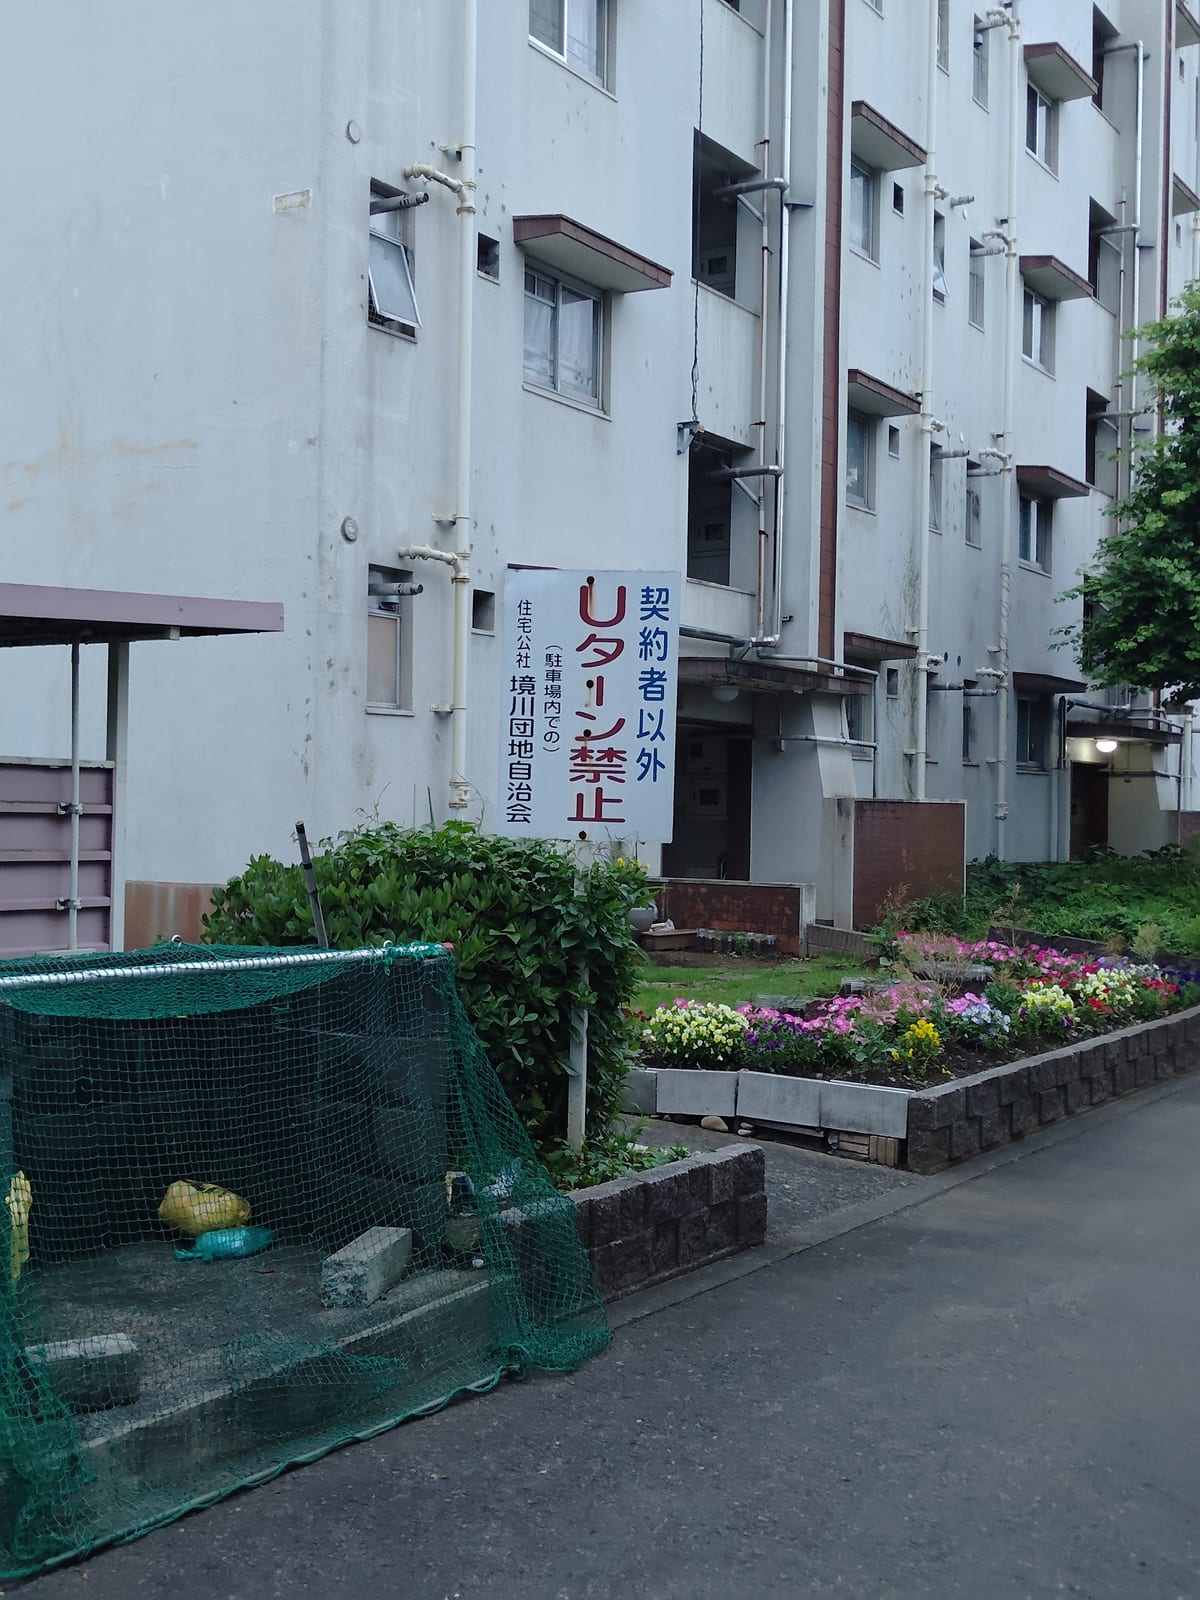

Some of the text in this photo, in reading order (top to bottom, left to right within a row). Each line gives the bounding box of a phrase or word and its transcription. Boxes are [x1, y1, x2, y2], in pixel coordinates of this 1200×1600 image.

[506, 599, 536, 824] 住宅公社 境川団地自治会
[567, 585, 627, 823] Uターン禁止
[636, 586, 670, 783] 契約者以外
